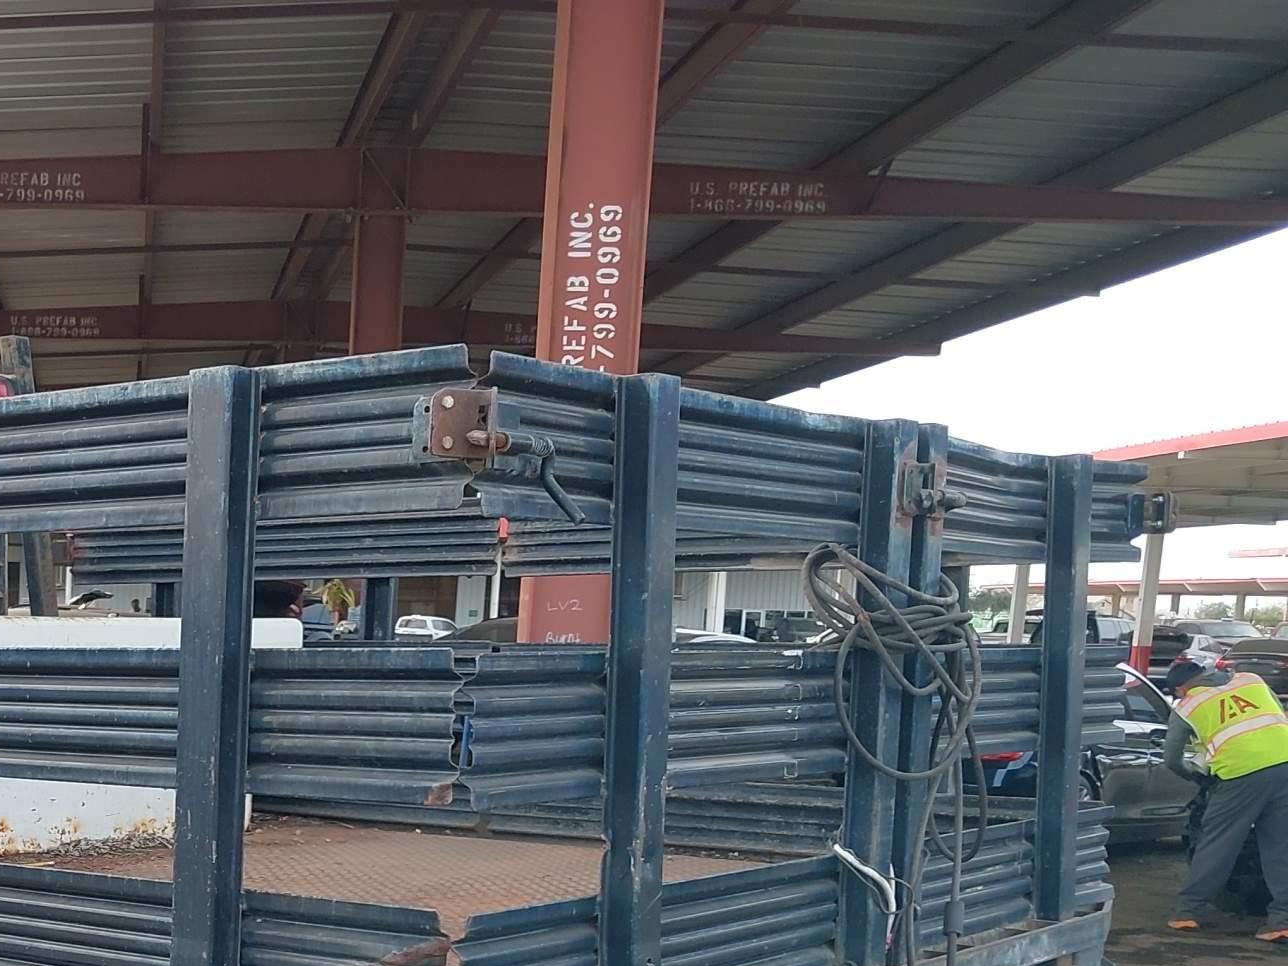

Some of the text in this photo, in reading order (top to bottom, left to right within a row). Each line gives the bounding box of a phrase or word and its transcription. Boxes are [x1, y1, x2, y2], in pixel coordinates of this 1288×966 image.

[728, 182, 791, 197] PREFAB
[567, 202, 595, 258] INC.
[34, 315, 77, 327] PREFAB
